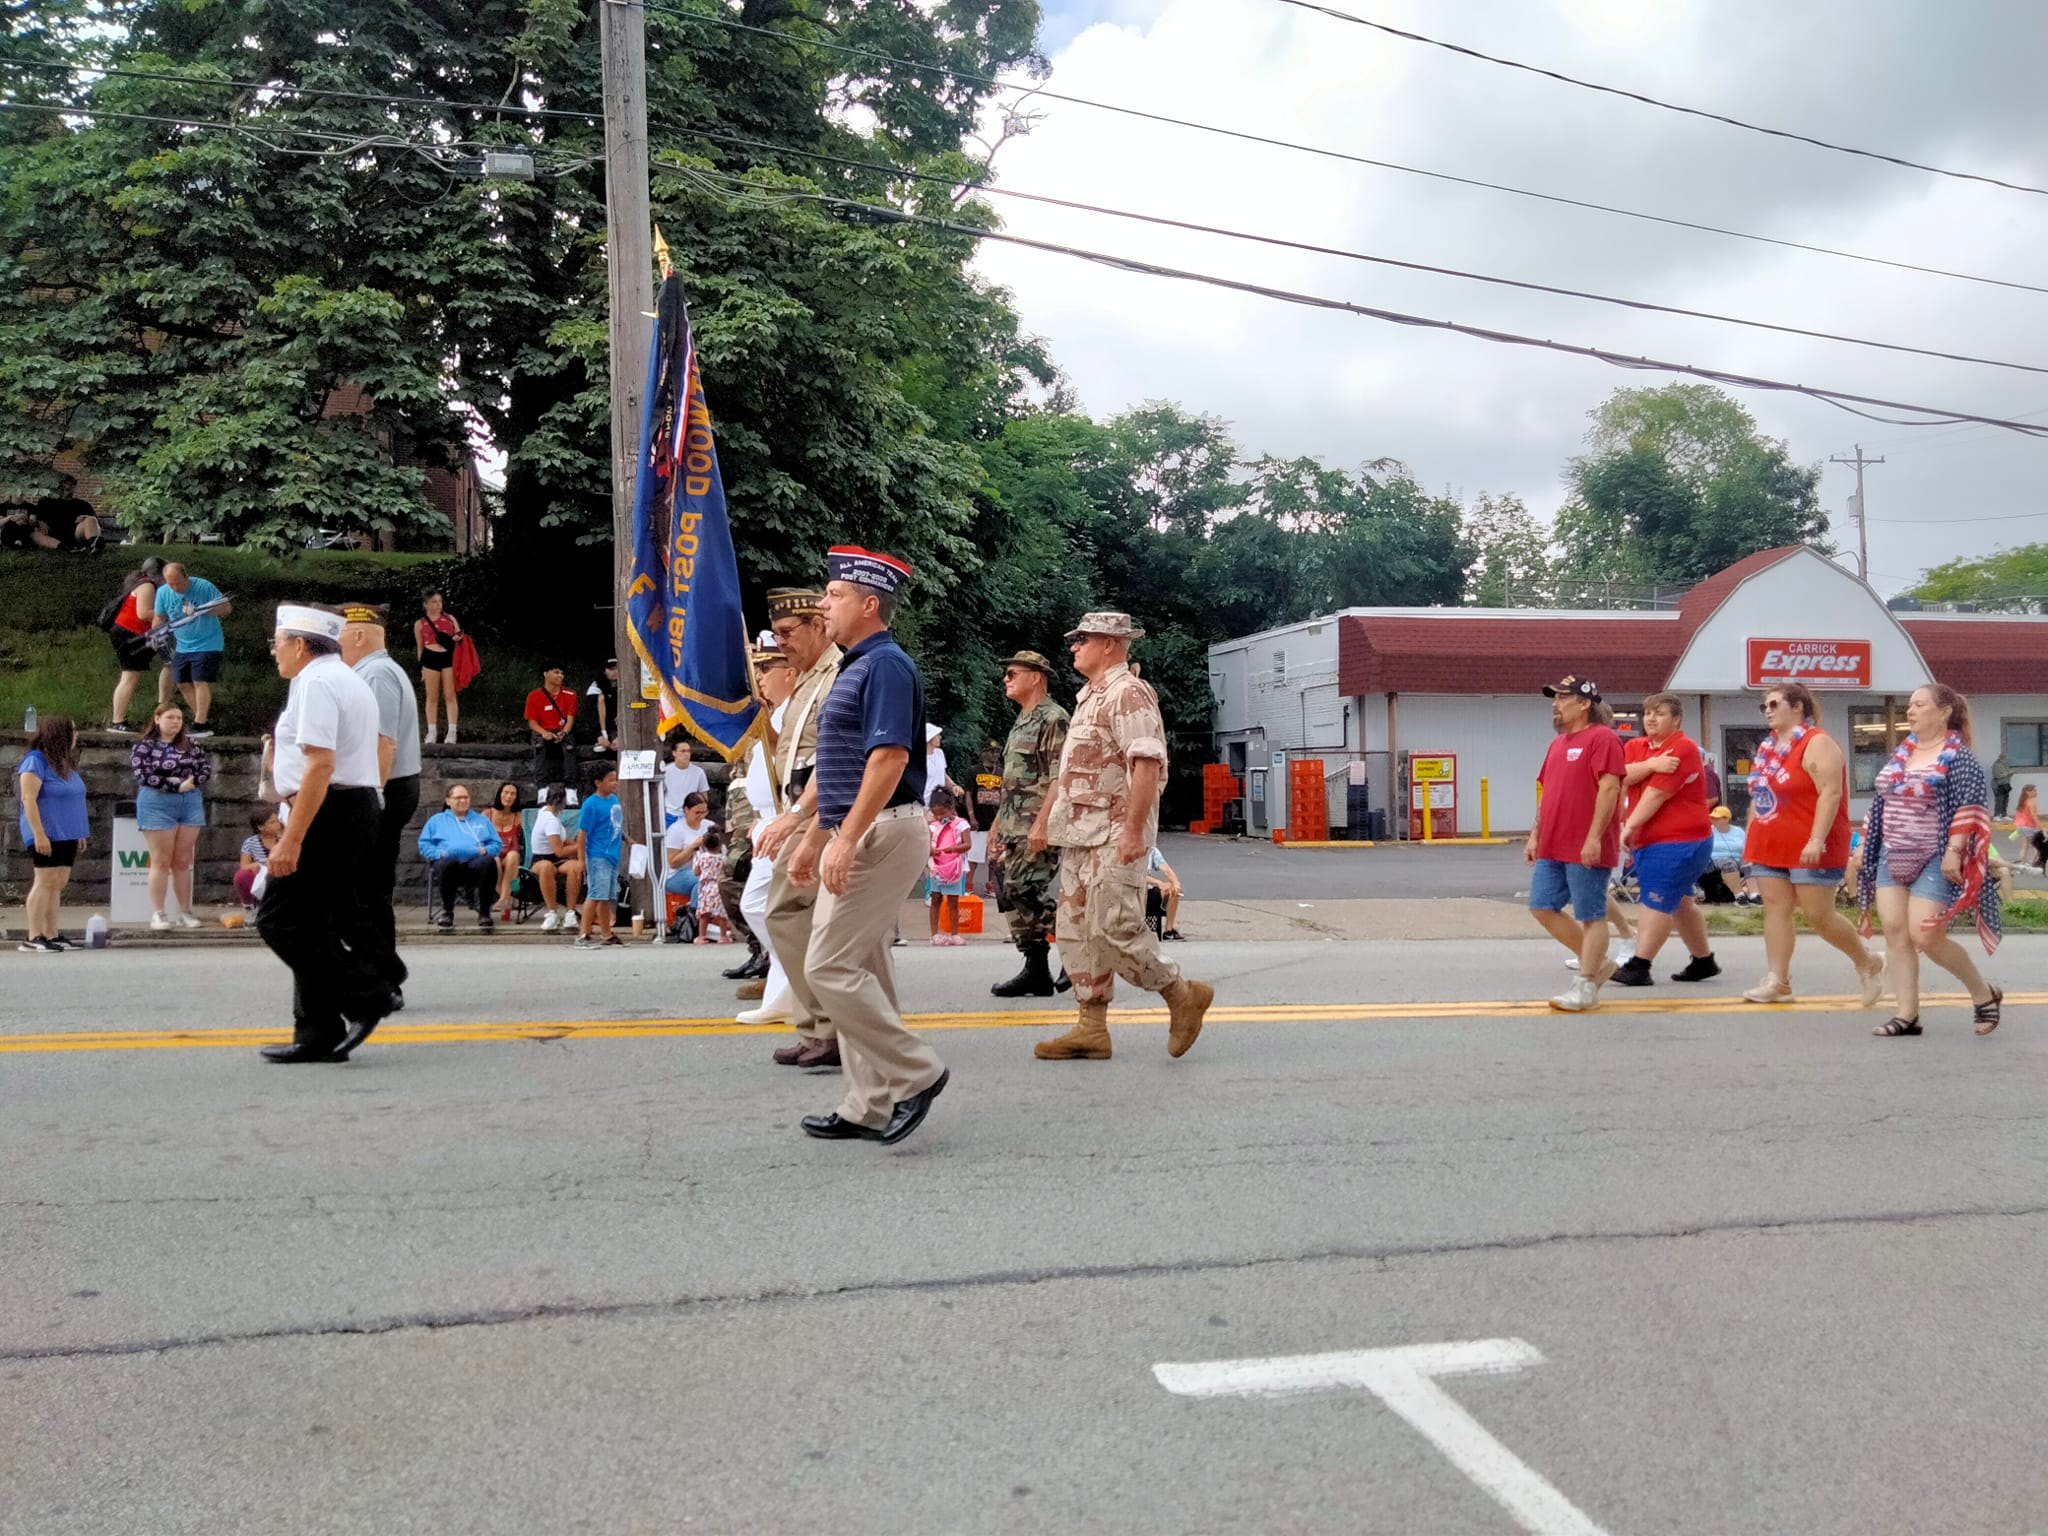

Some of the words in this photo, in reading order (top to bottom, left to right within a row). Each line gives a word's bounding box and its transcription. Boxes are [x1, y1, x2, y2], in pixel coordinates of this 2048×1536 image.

[839, 561, 853, 570] ALL
[854, 560, 886, 572] AMERICAN
[886, 568, 899, 584] TEAM
[840, 573, 857, 581] POST
[858, 576, 894, 592] COMMANDER
[1788, 643, 1837, 654] CARRICK
[1761, 650, 1861, 676] Express
